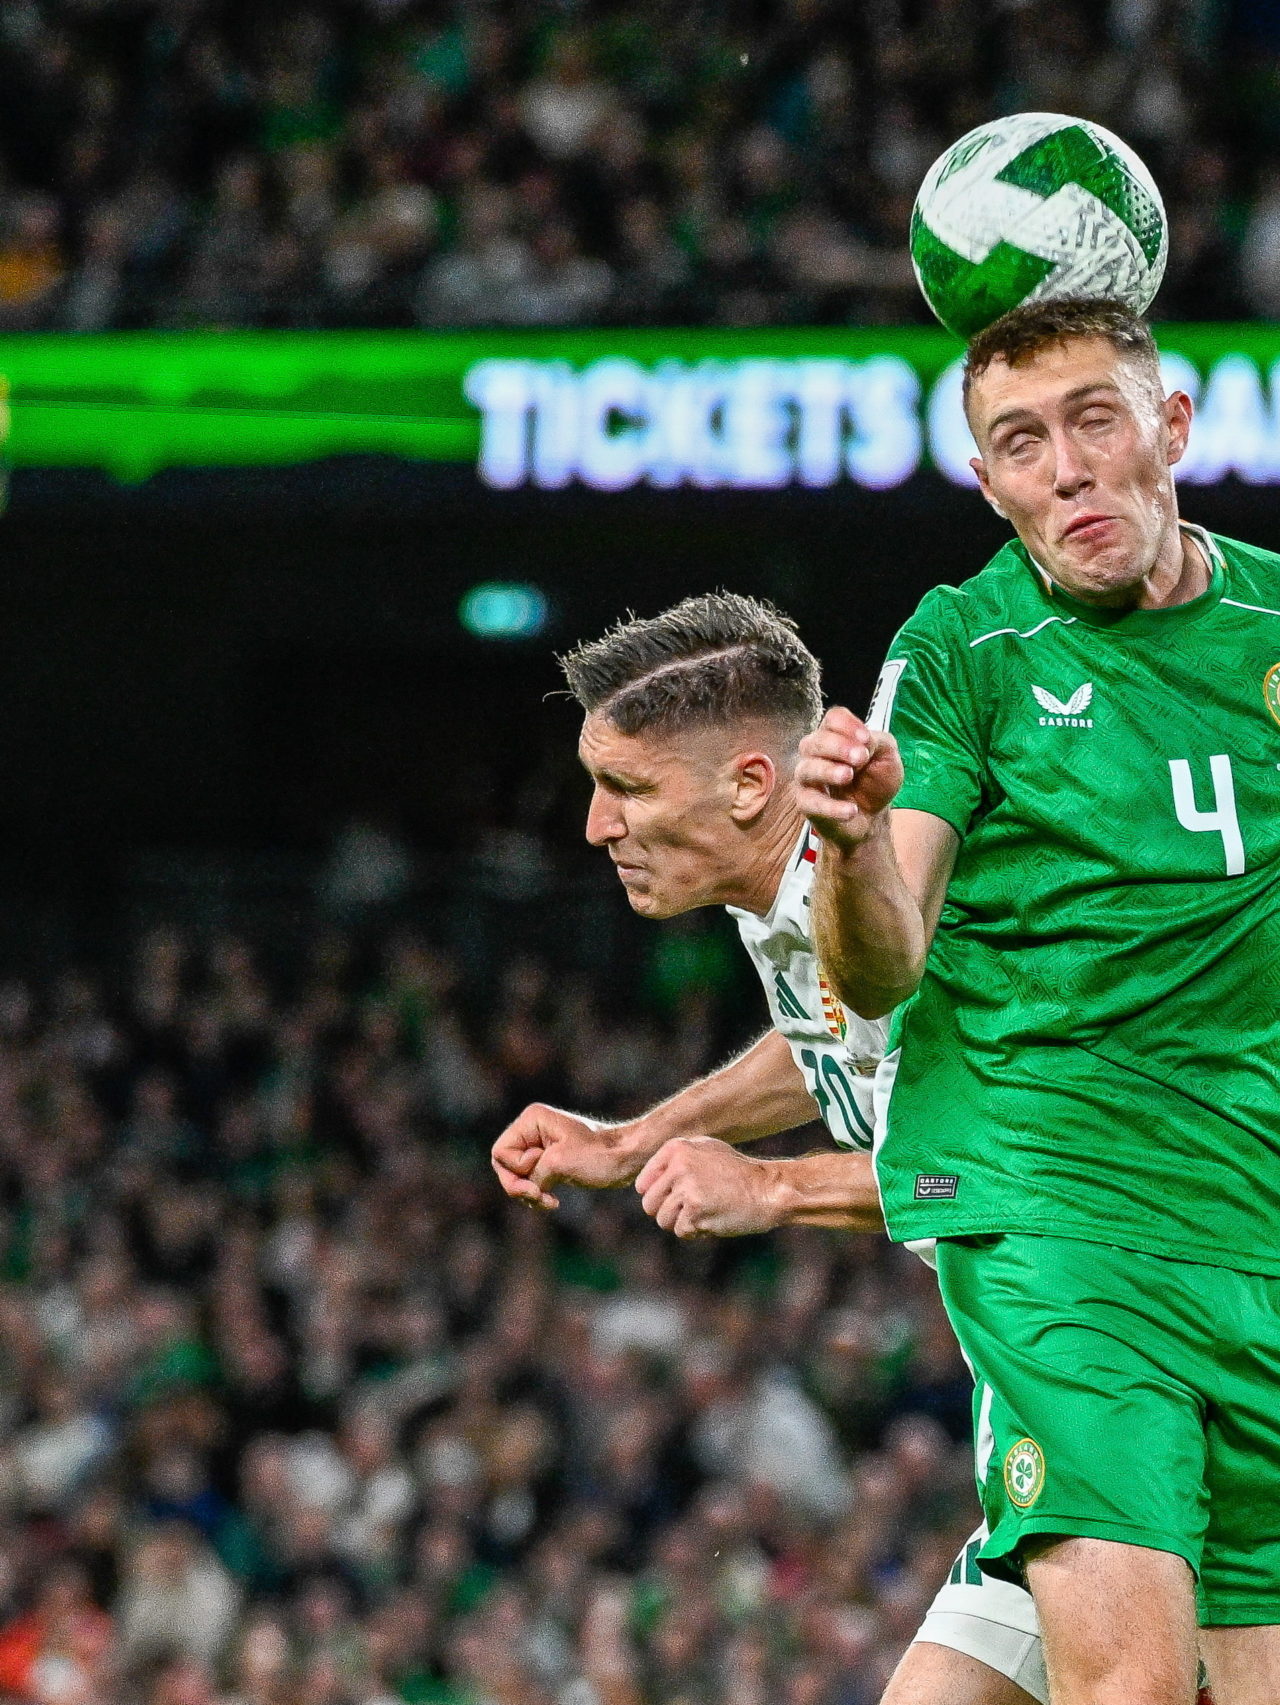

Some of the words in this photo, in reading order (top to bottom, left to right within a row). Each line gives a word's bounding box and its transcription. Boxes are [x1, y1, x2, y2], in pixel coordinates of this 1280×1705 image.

[464, 356, 920, 490] TICKETS
[1038, 717, 1094, 729] CASTORE
[1168, 754, 1245, 877] 4
